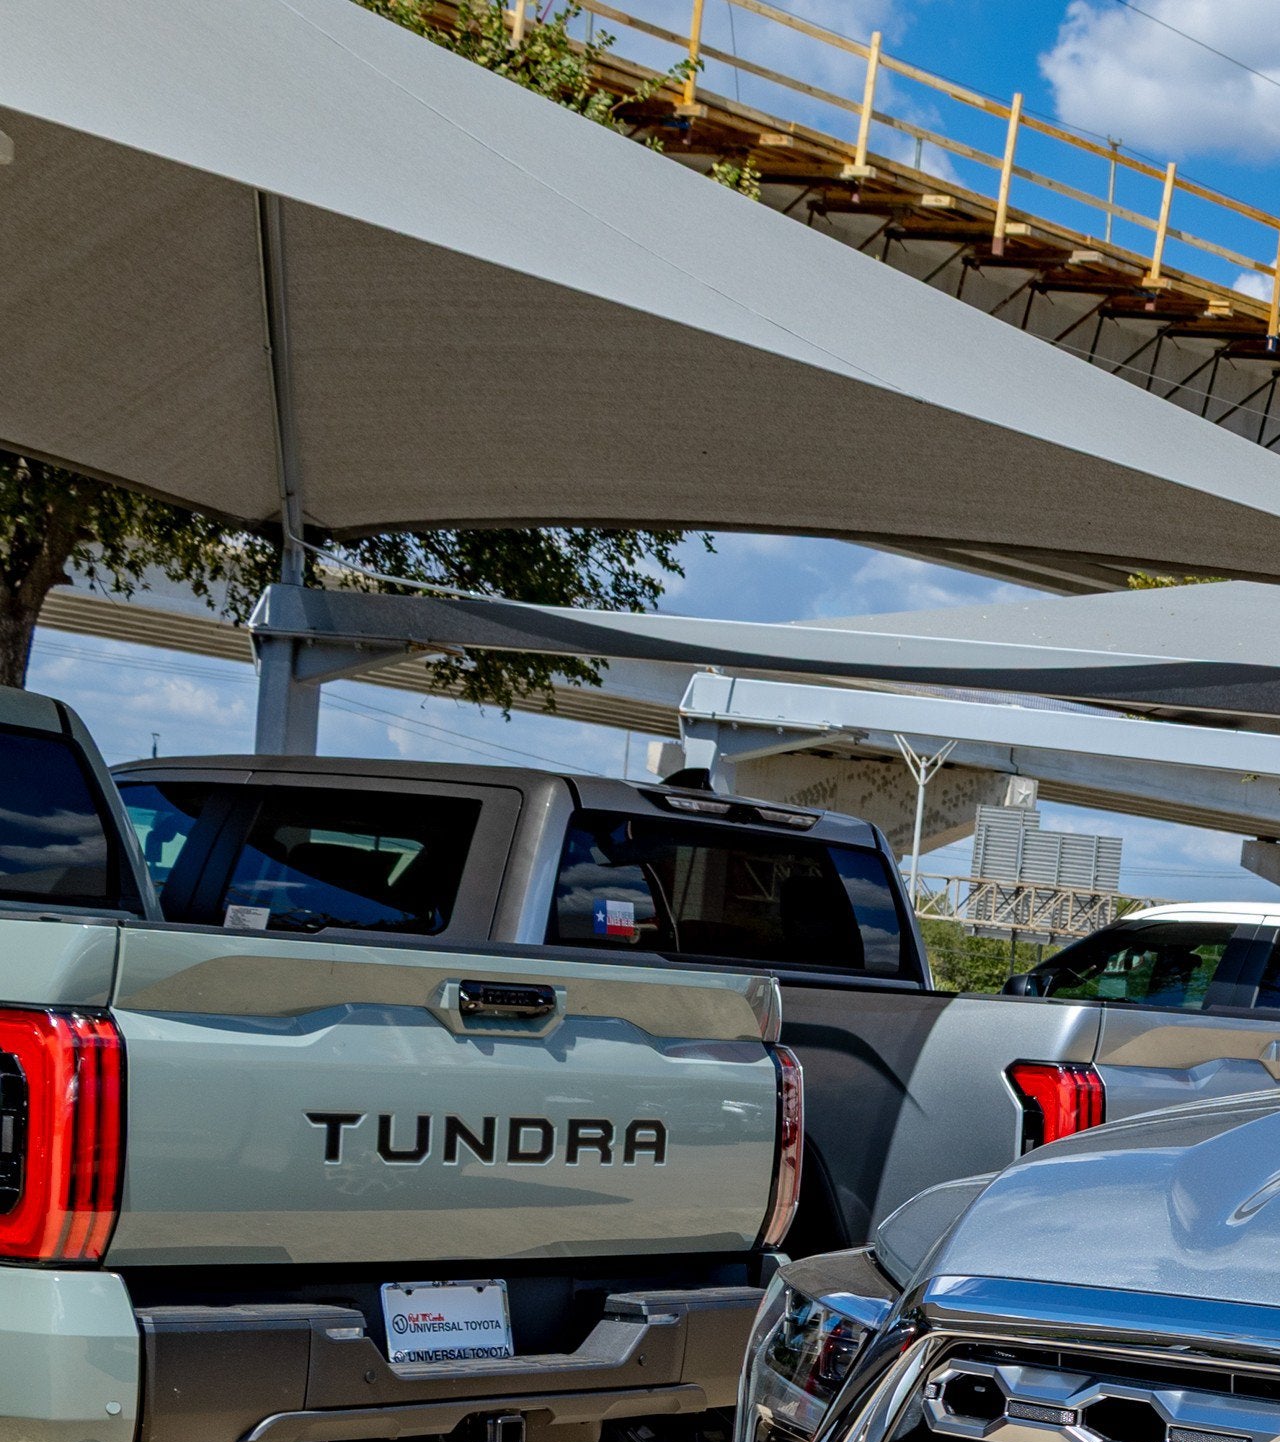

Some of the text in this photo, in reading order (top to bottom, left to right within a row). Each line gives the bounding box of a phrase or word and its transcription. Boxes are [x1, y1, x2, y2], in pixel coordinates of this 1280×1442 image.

[303, 1111, 668, 1166] TUNDRA
[409, 1320, 501, 1333] UNIVERSAL TOYOTA
[408, 1349, 470, 1362] UNIVERSAL
[470, 1346, 511, 1359] TOYOTA
